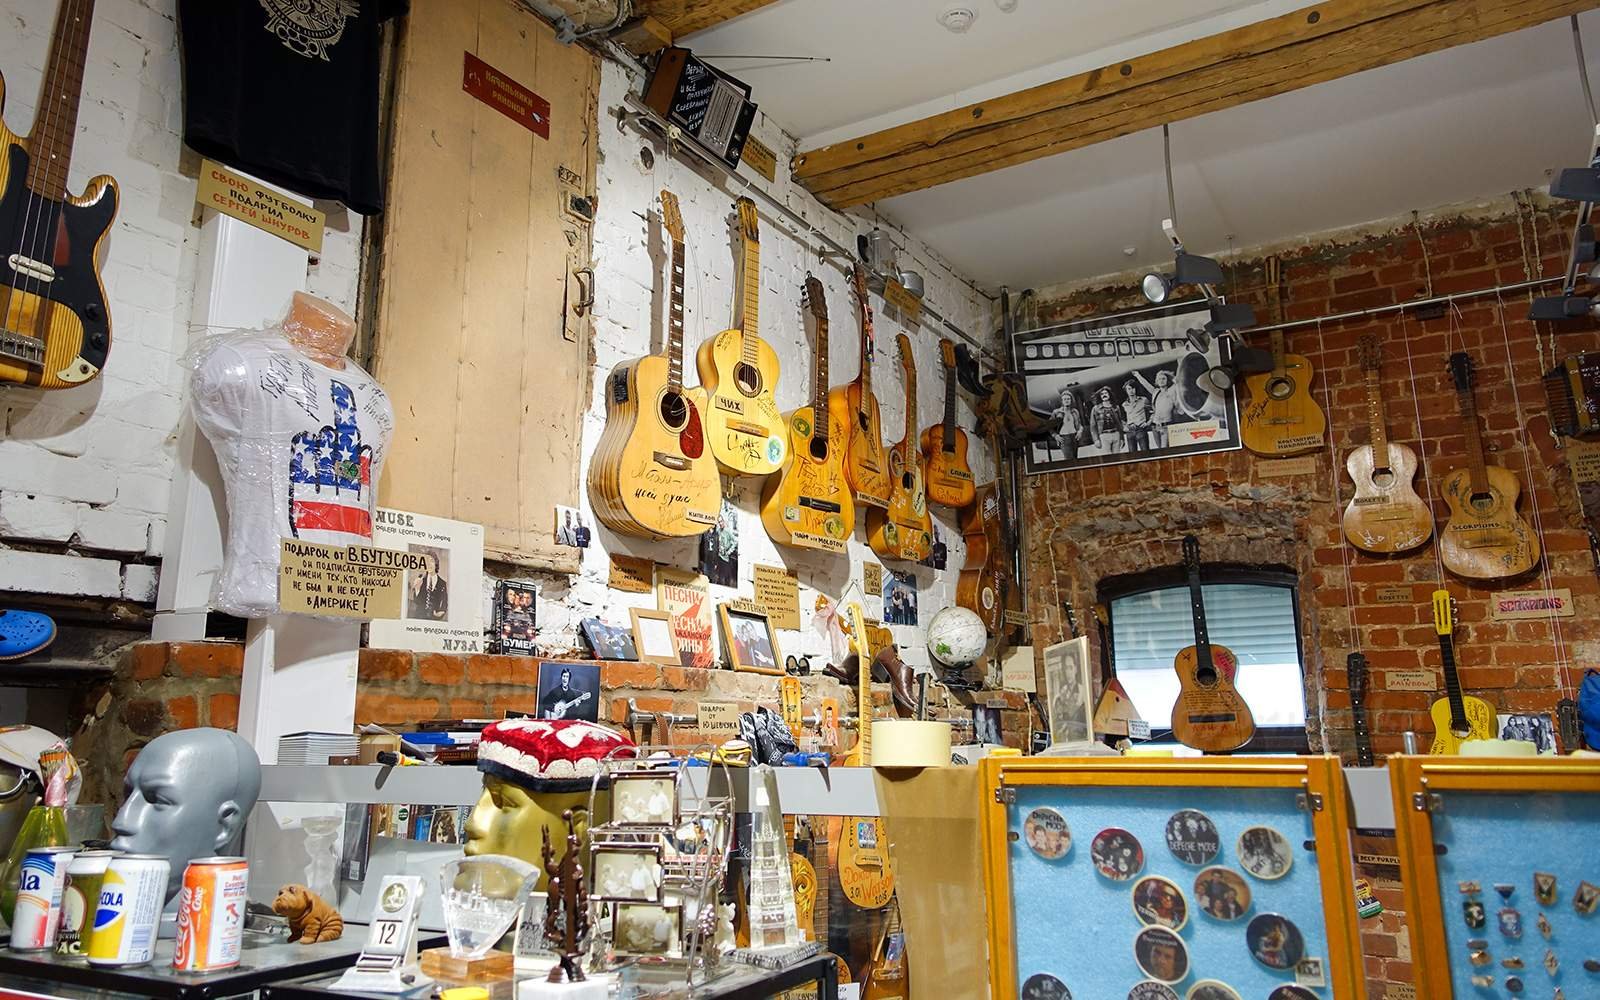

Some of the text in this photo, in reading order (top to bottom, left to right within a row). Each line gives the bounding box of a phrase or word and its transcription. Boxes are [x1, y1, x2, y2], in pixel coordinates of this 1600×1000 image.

[211, 171, 317, 224] СВОЮ ФУТБОЛКУ
[230, 189, 284, 220] ПОДАРИЛ
[213, 192, 311, 240] СЕРГЕЙ ШНУРОВ
[376, 511, 414, 527] MUSE
[1452, 522, 1501, 531] SCORPIONS
[284, 542, 330, 559] ПОДАРОК
[347, 546, 428, 571] В.БУТУСОВА
[285, 566, 293, 575] ОТ
[297, 568, 322, 581] ИМЕНИ
[361, 577, 391, 588] НИКОГДА
[302, 560, 399, 578] ОН ПОДПИСАЛ ФУТБОЛКУ
[292, 581, 375, 597] НЕ БЫЛ И НЕ БУДЕТ
[664, 586, 702, 606] ПЕСНИ
[1499, 598, 1563, 612] SCORPIONS
[442, 639, 479, 652] МУЗА
[503, 638, 535, 649] БУМЕР
[1168, 841, 1217, 853] DEPECHE MODE
[379, 923, 397, 945] 12
